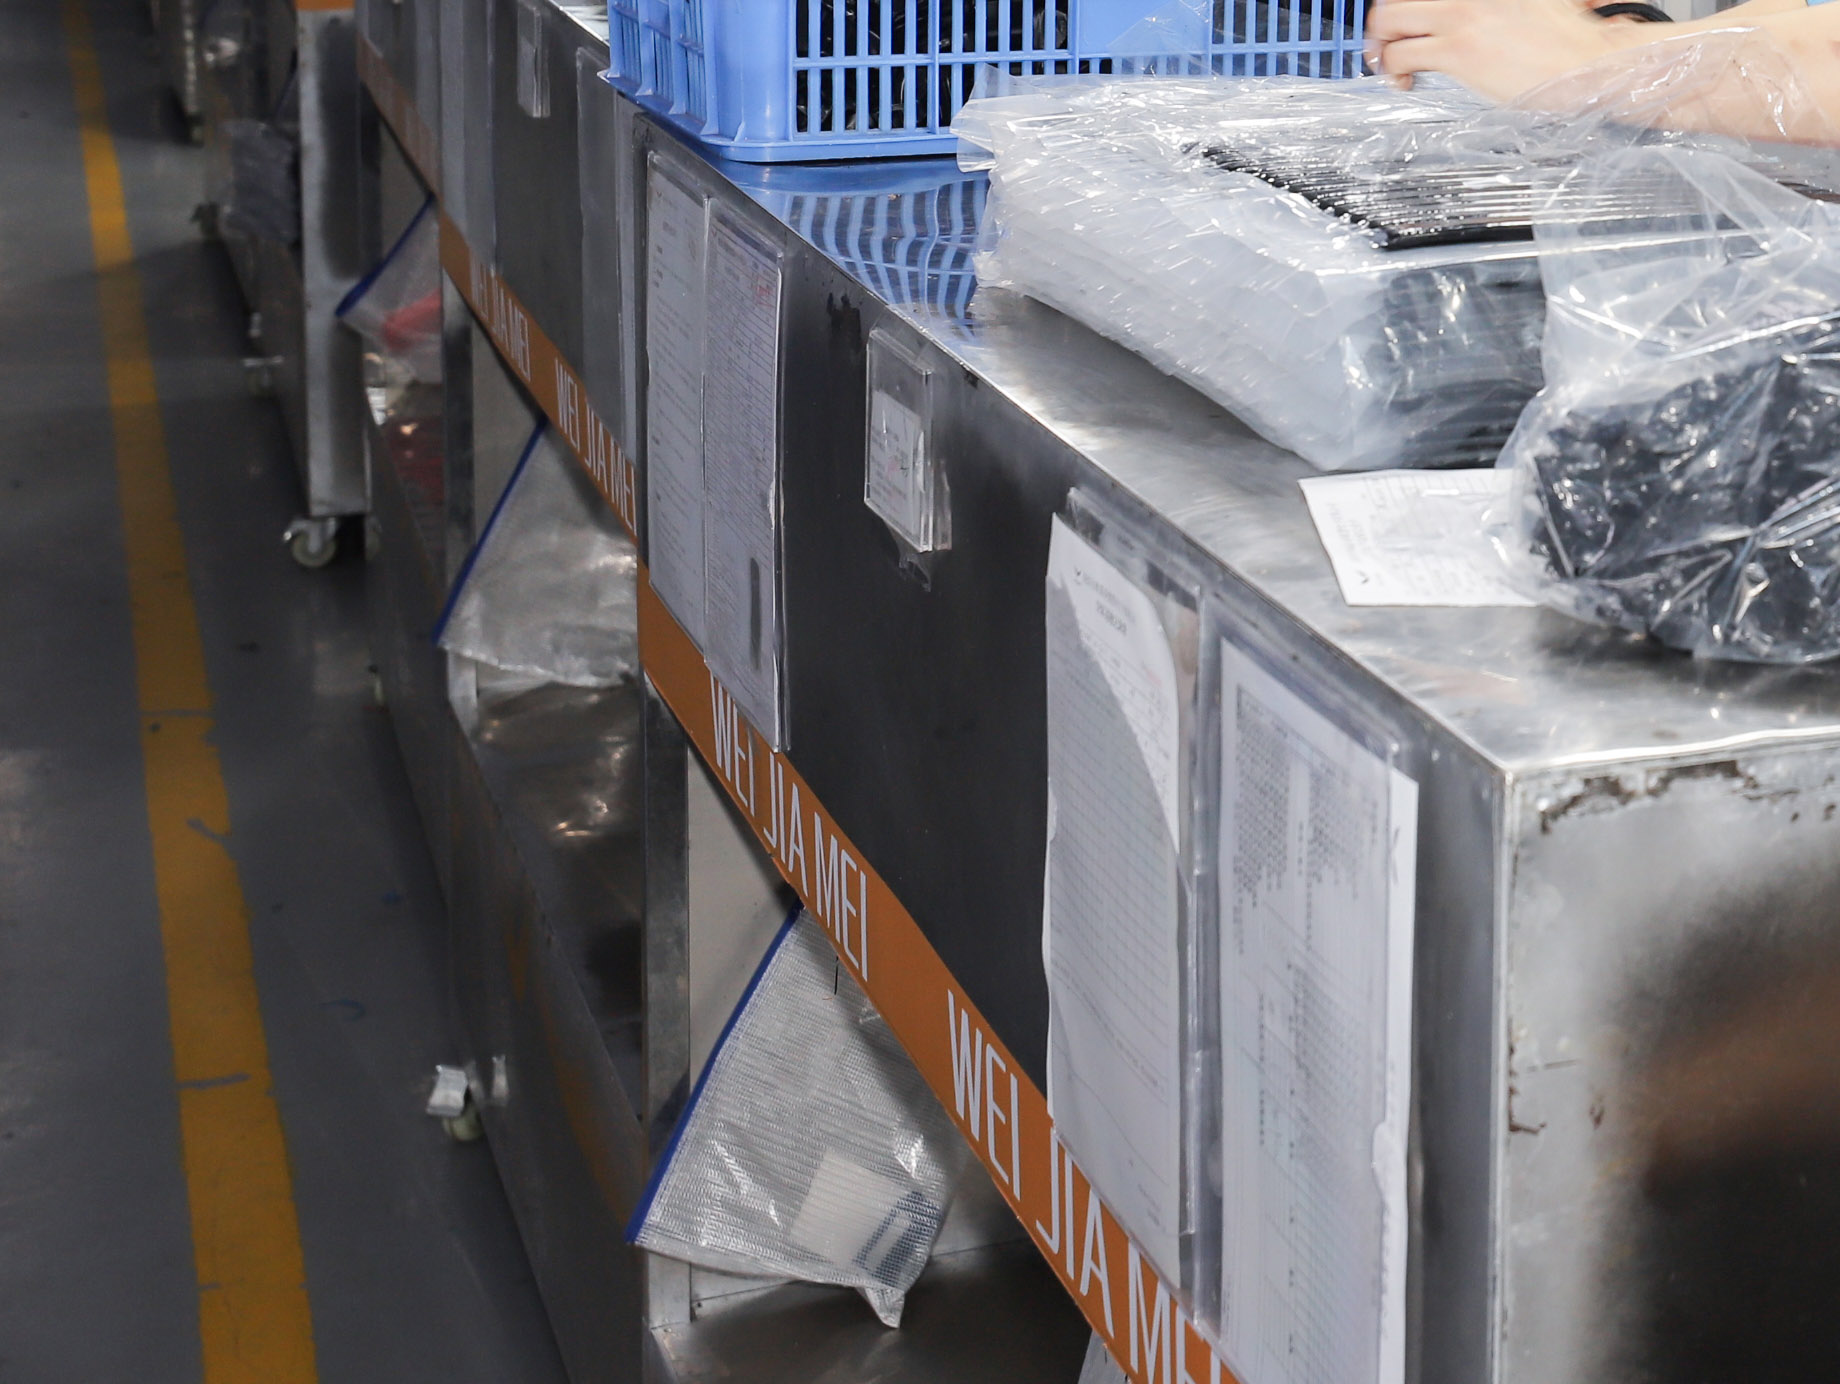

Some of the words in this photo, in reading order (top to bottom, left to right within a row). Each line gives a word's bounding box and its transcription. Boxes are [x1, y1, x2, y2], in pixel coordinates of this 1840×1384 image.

[555, 357, 580, 454] WEI
[584, 400, 609, 494] JIA
[610, 434, 637, 537] MEI
[710, 669, 755, 817] WEI
[763, 751, 808, 897] JIA
[814, 811, 868, 982] MEI
[948, 989, 1021, 1203] WEI
[1036, 1126, 1115, 1340] JIA
